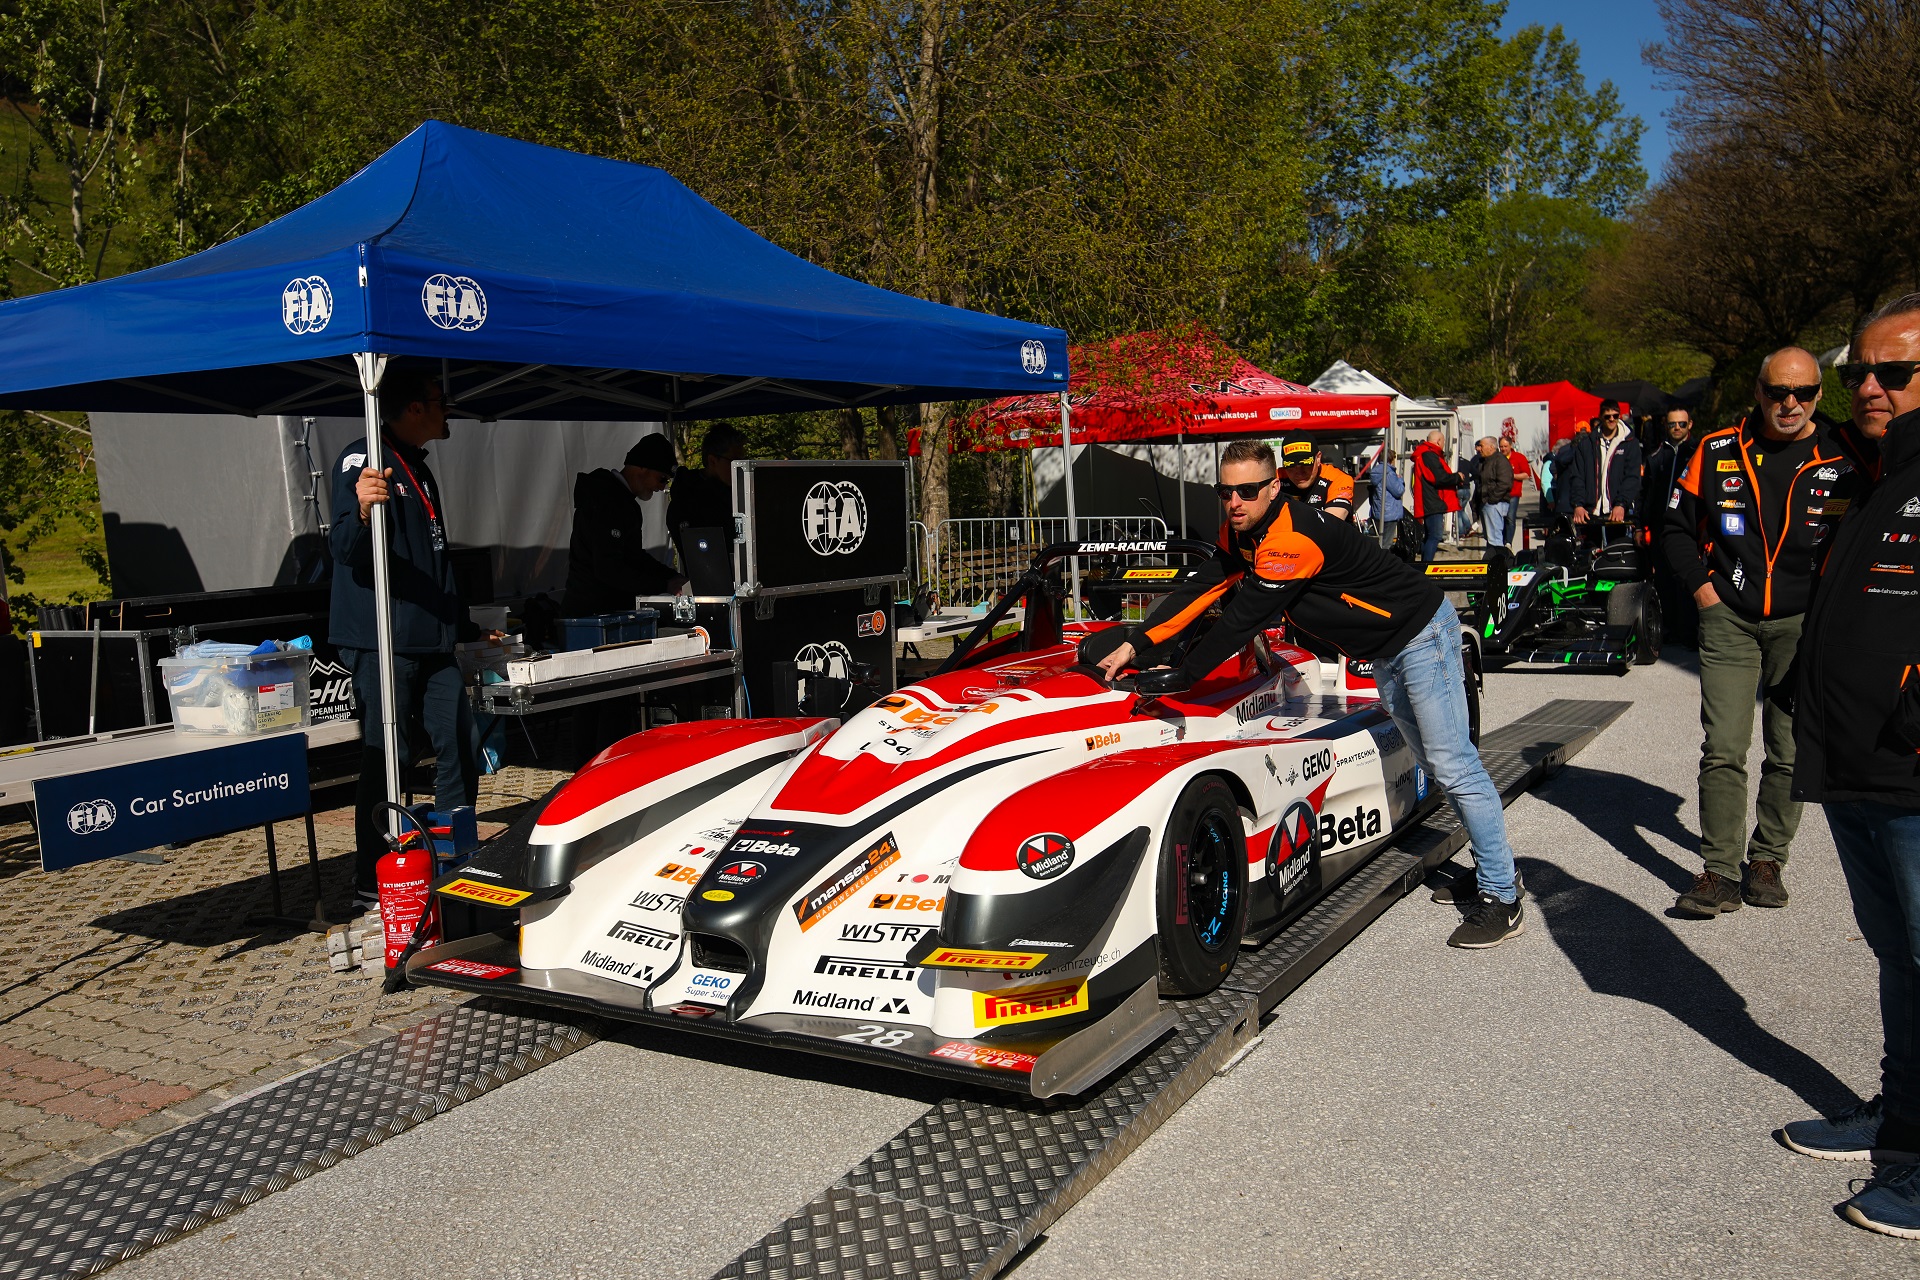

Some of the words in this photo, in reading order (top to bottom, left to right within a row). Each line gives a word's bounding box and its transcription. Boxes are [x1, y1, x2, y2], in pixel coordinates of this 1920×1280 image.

[1271, 409, 1300, 418] UNIKATOY
[1309, 408, 1378, 418] www.mgmracing.si
[1077, 541, 1168, 553] ZEMP-RACING
[1431, 566, 1485, 574] PIRELLI
[1095, 731, 1121, 749] Beta
[1302, 747, 1331, 781] GEKO
[1336, 747, 1377, 768] SPRAYTECHNIK
[129, 797, 167, 817] Car
[172, 771, 290, 809] Scrutineering
[1320, 805, 1382, 850] Beta
[747, 839, 801, 857] Beta
[1031, 850, 1070, 875] Midland
[1278, 845, 1312, 889] Midland
[382, 879, 425, 889] EXTINCTEUR
[671, 866, 703, 886] Be
[449, 882, 521, 903] PIRELLI
[894, 894, 945, 912] Bet
[1219, 871, 1229, 916] RACING
[606, 920, 680, 951] PIRELLI
[432, 961, 492, 977] REVUE
[579, 949, 636, 976] Midland
[813, 955, 922, 982] PIRELLI
[934, 952, 1033, 967] PIRELLI
[691, 973, 731, 989] GEKO
[684, 986, 710, 999] Super
[711, 990, 731, 1000] Silen
[792, 989, 876, 1012] Midland
[985, 984, 1079, 1020] PIRELLI
[836, 1024, 915, 1048] 28
[933, 1048, 1022, 1068] REVUE
[948, 1042, 1038, 1065] AUTOMOBIL
